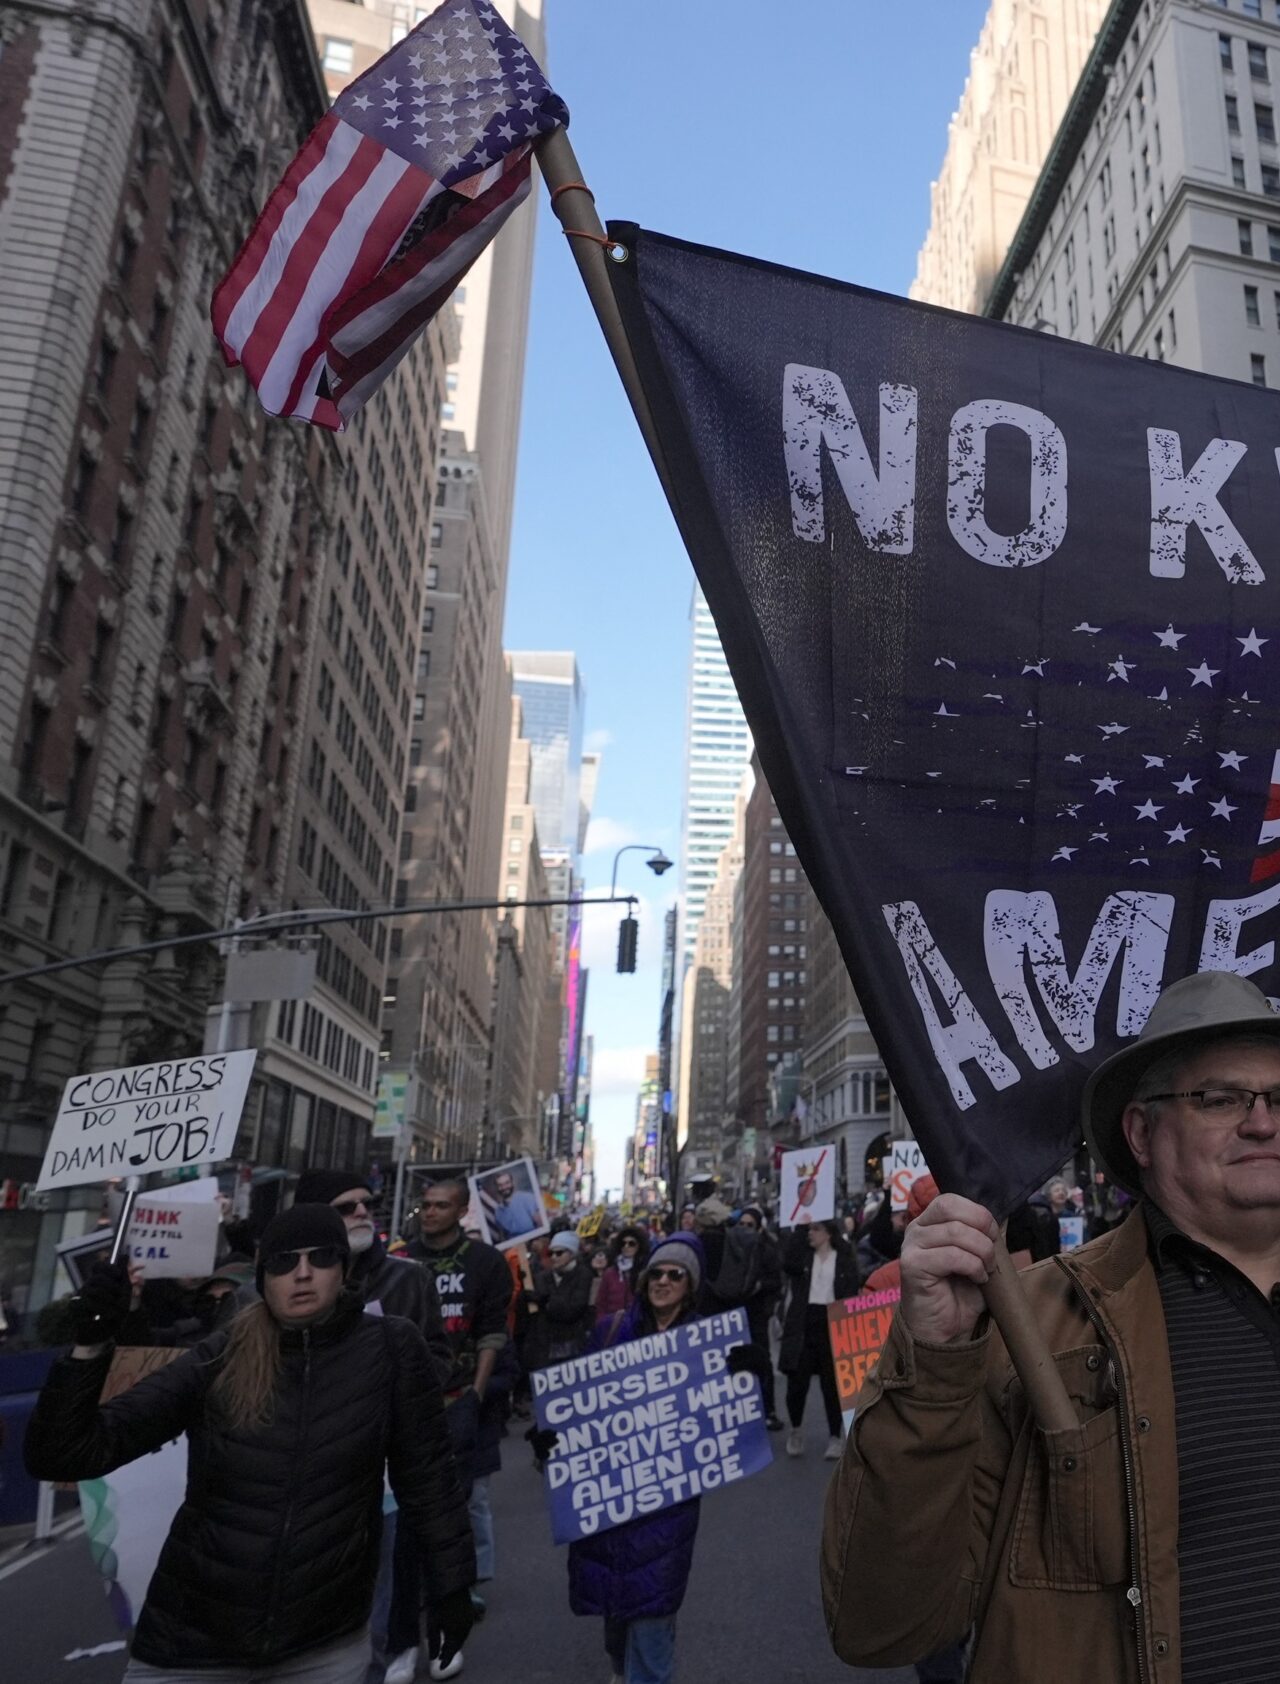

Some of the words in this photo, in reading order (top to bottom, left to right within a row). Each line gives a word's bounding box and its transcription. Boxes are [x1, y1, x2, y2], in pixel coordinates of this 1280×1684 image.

[782, 363, 1068, 568] NO
[69, 1056, 226, 1107] CONGRESS
[82, 1108, 116, 1131] DO
[134, 1093, 200, 1123] YOUR
[51, 1139, 127, 1177] DAMN
[128, 1111, 224, 1166] JOB!
[134, 1207, 182, 1225] HINK
[533, 1329, 678, 1397] DEUTERONOMY
[686, 1310, 743, 1347] 27:19
[545, 1361, 689, 1424] CURSED
[548, 1394, 679, 1460] ANYONE
[687, 1371, 754, 1413] WHO
[548, 1416, 700, 1489] DEPRIVES
[707, 1395, 762, 1433] THE
[572, 1449, 684, 1510] ALIEN
[694, 1429, 739, 1464] OF
[579, 1453, 743, 1535] JUSTICE
